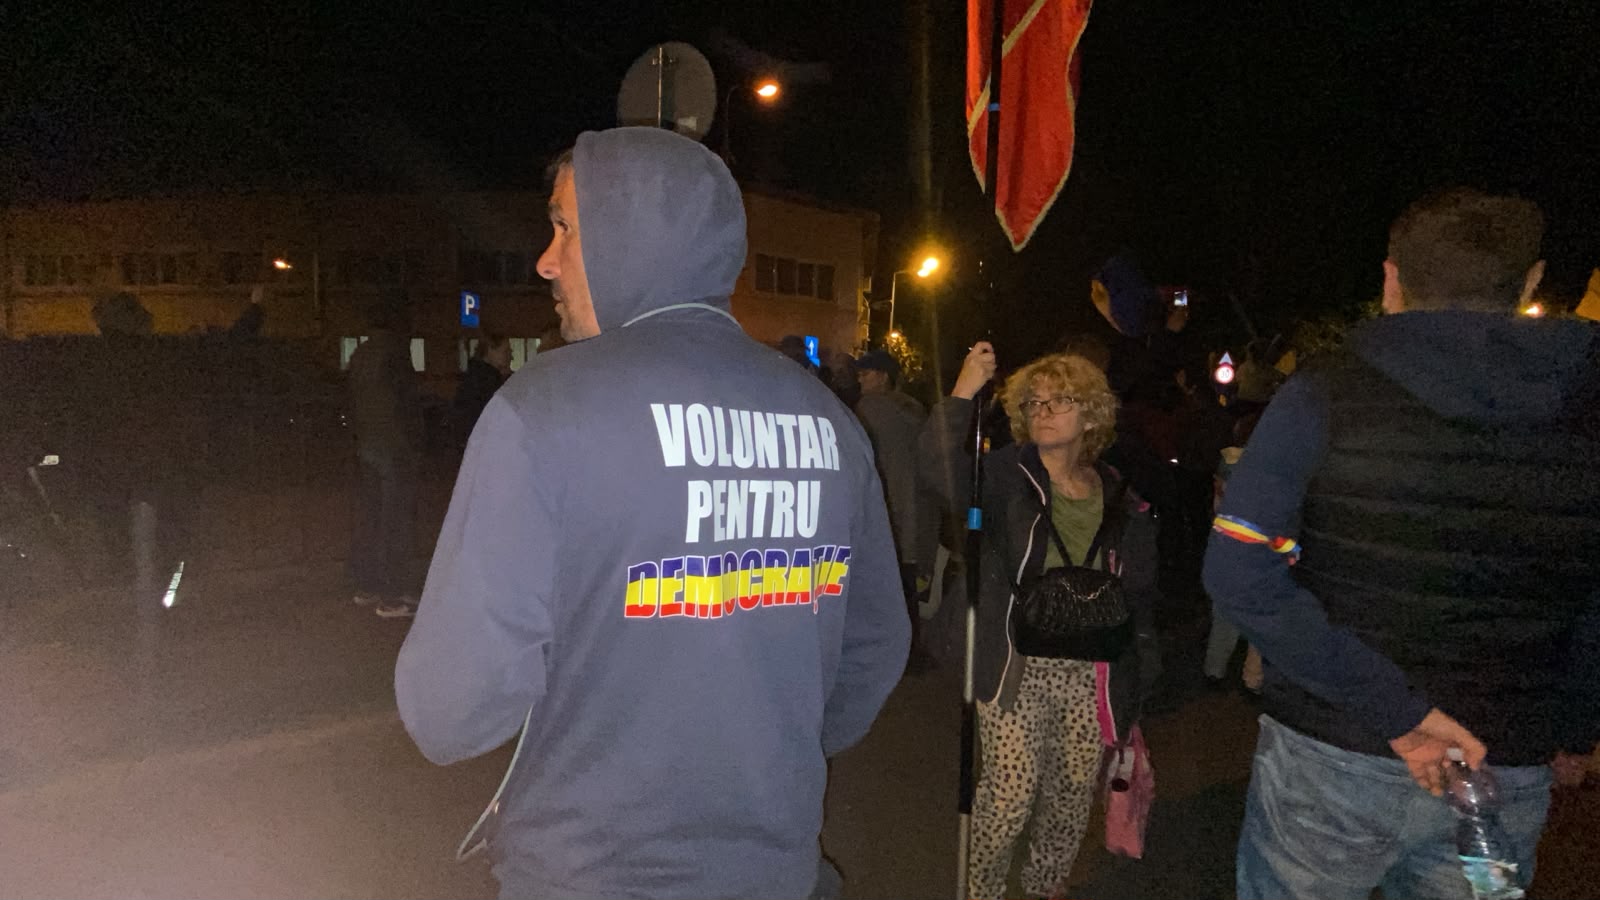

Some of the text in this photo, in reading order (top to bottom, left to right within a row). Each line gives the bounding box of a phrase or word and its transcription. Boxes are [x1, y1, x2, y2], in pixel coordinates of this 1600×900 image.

[465, 294, 475, 316] P
[651, 403, 840, 470] VOLUNTAR
[685, 480, 820, 543] PENTRU
